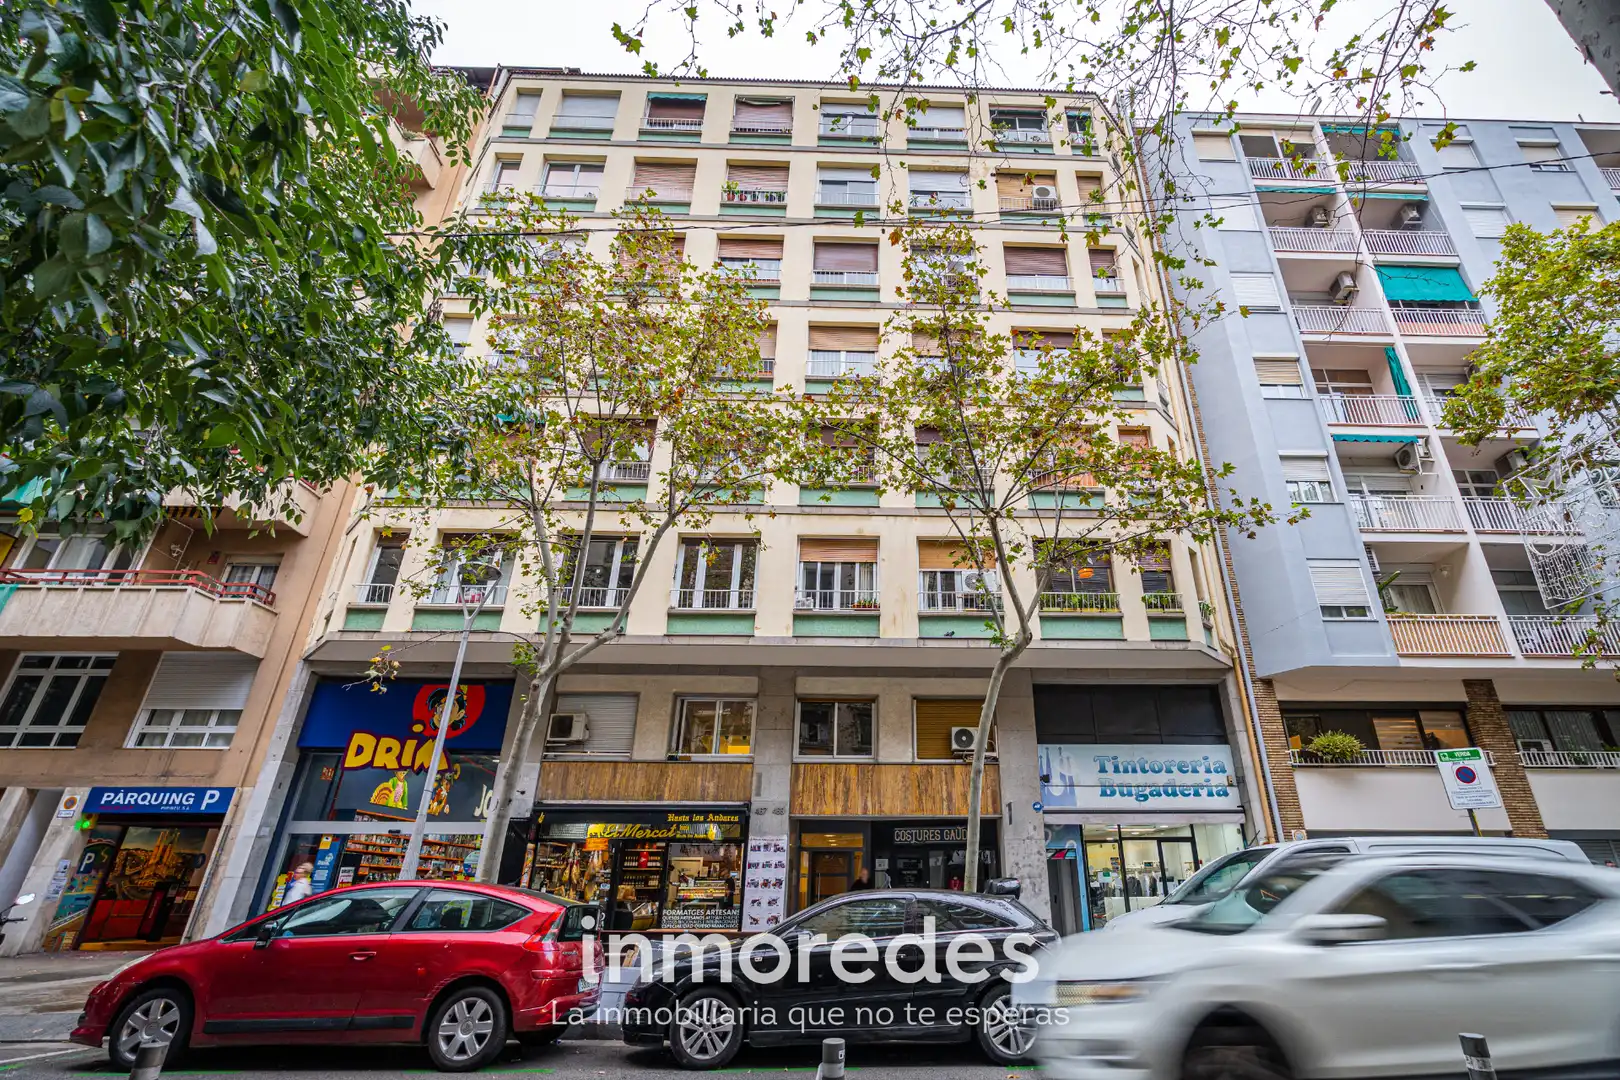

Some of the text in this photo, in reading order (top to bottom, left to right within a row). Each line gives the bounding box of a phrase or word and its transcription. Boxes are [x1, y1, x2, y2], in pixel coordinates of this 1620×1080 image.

[1093, 755, 1227, 774] Tintoreria
[100, 790, 196, 805] PÀRQUING
[1098, 778, 1230, 802] Bugaderia
[667, 813, 739, 822] Hasta los Andares
[618, 824, 677, 839] Mercat
[894, 826, 967, 843] COSTURES GAUD
